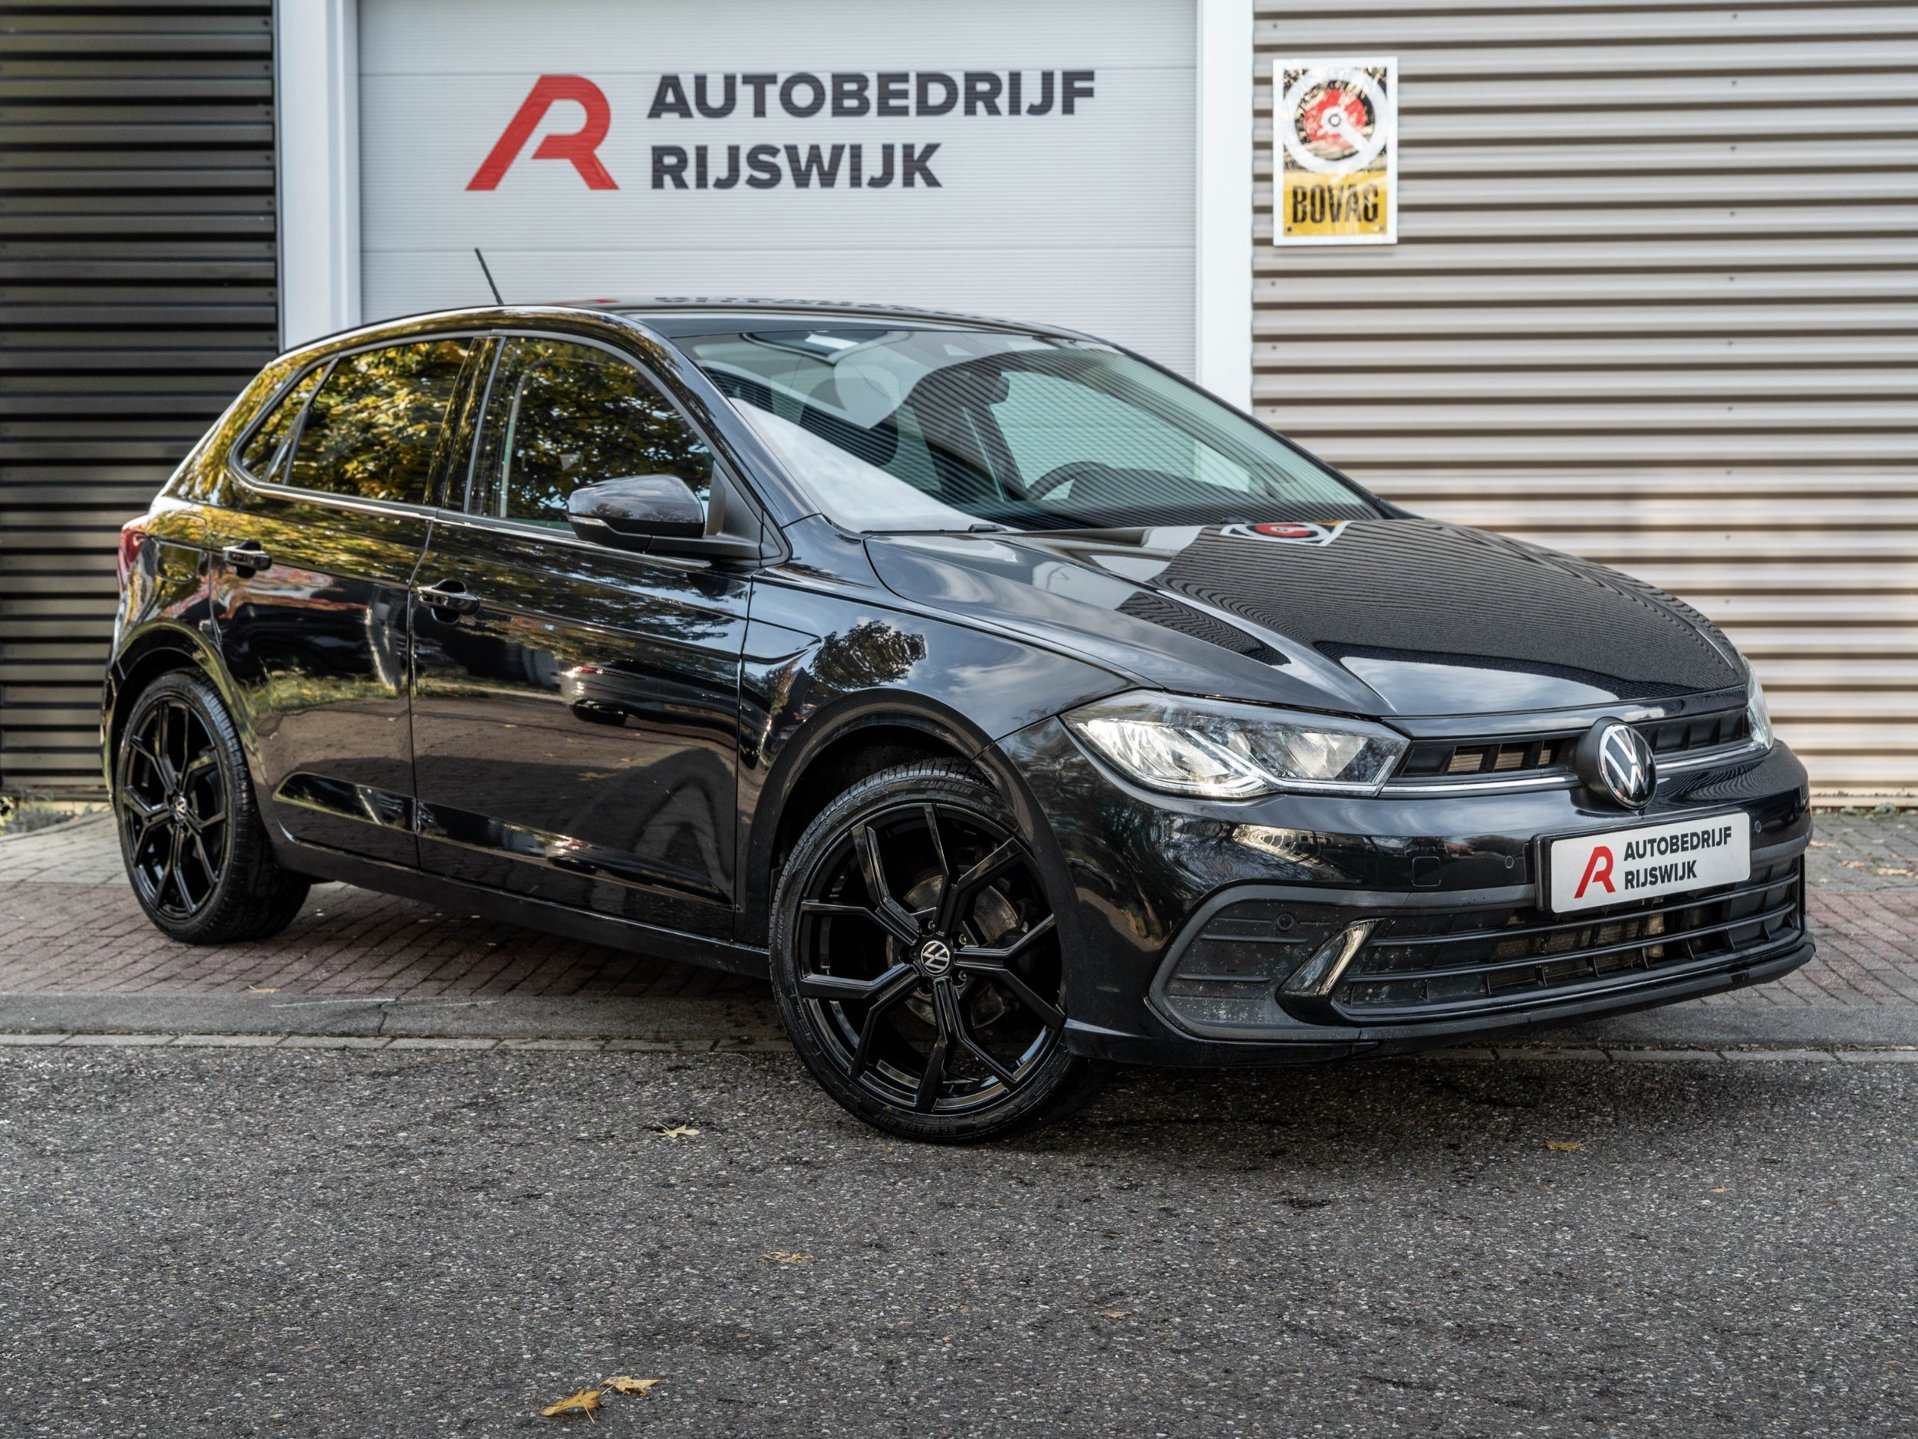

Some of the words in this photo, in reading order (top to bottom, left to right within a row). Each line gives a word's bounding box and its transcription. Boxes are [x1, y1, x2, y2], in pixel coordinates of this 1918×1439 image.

[647, 70, 1095, 119] AUTOBEDRIJF
[651, 143, 942, 190] RIJSWIJK
[1292, 184, 1379, 224] BOVAG
[1623, 826, 1732, 862] AUTOBEDRIJF
[1624, 860, 1697, 890] RIJSWIJK
